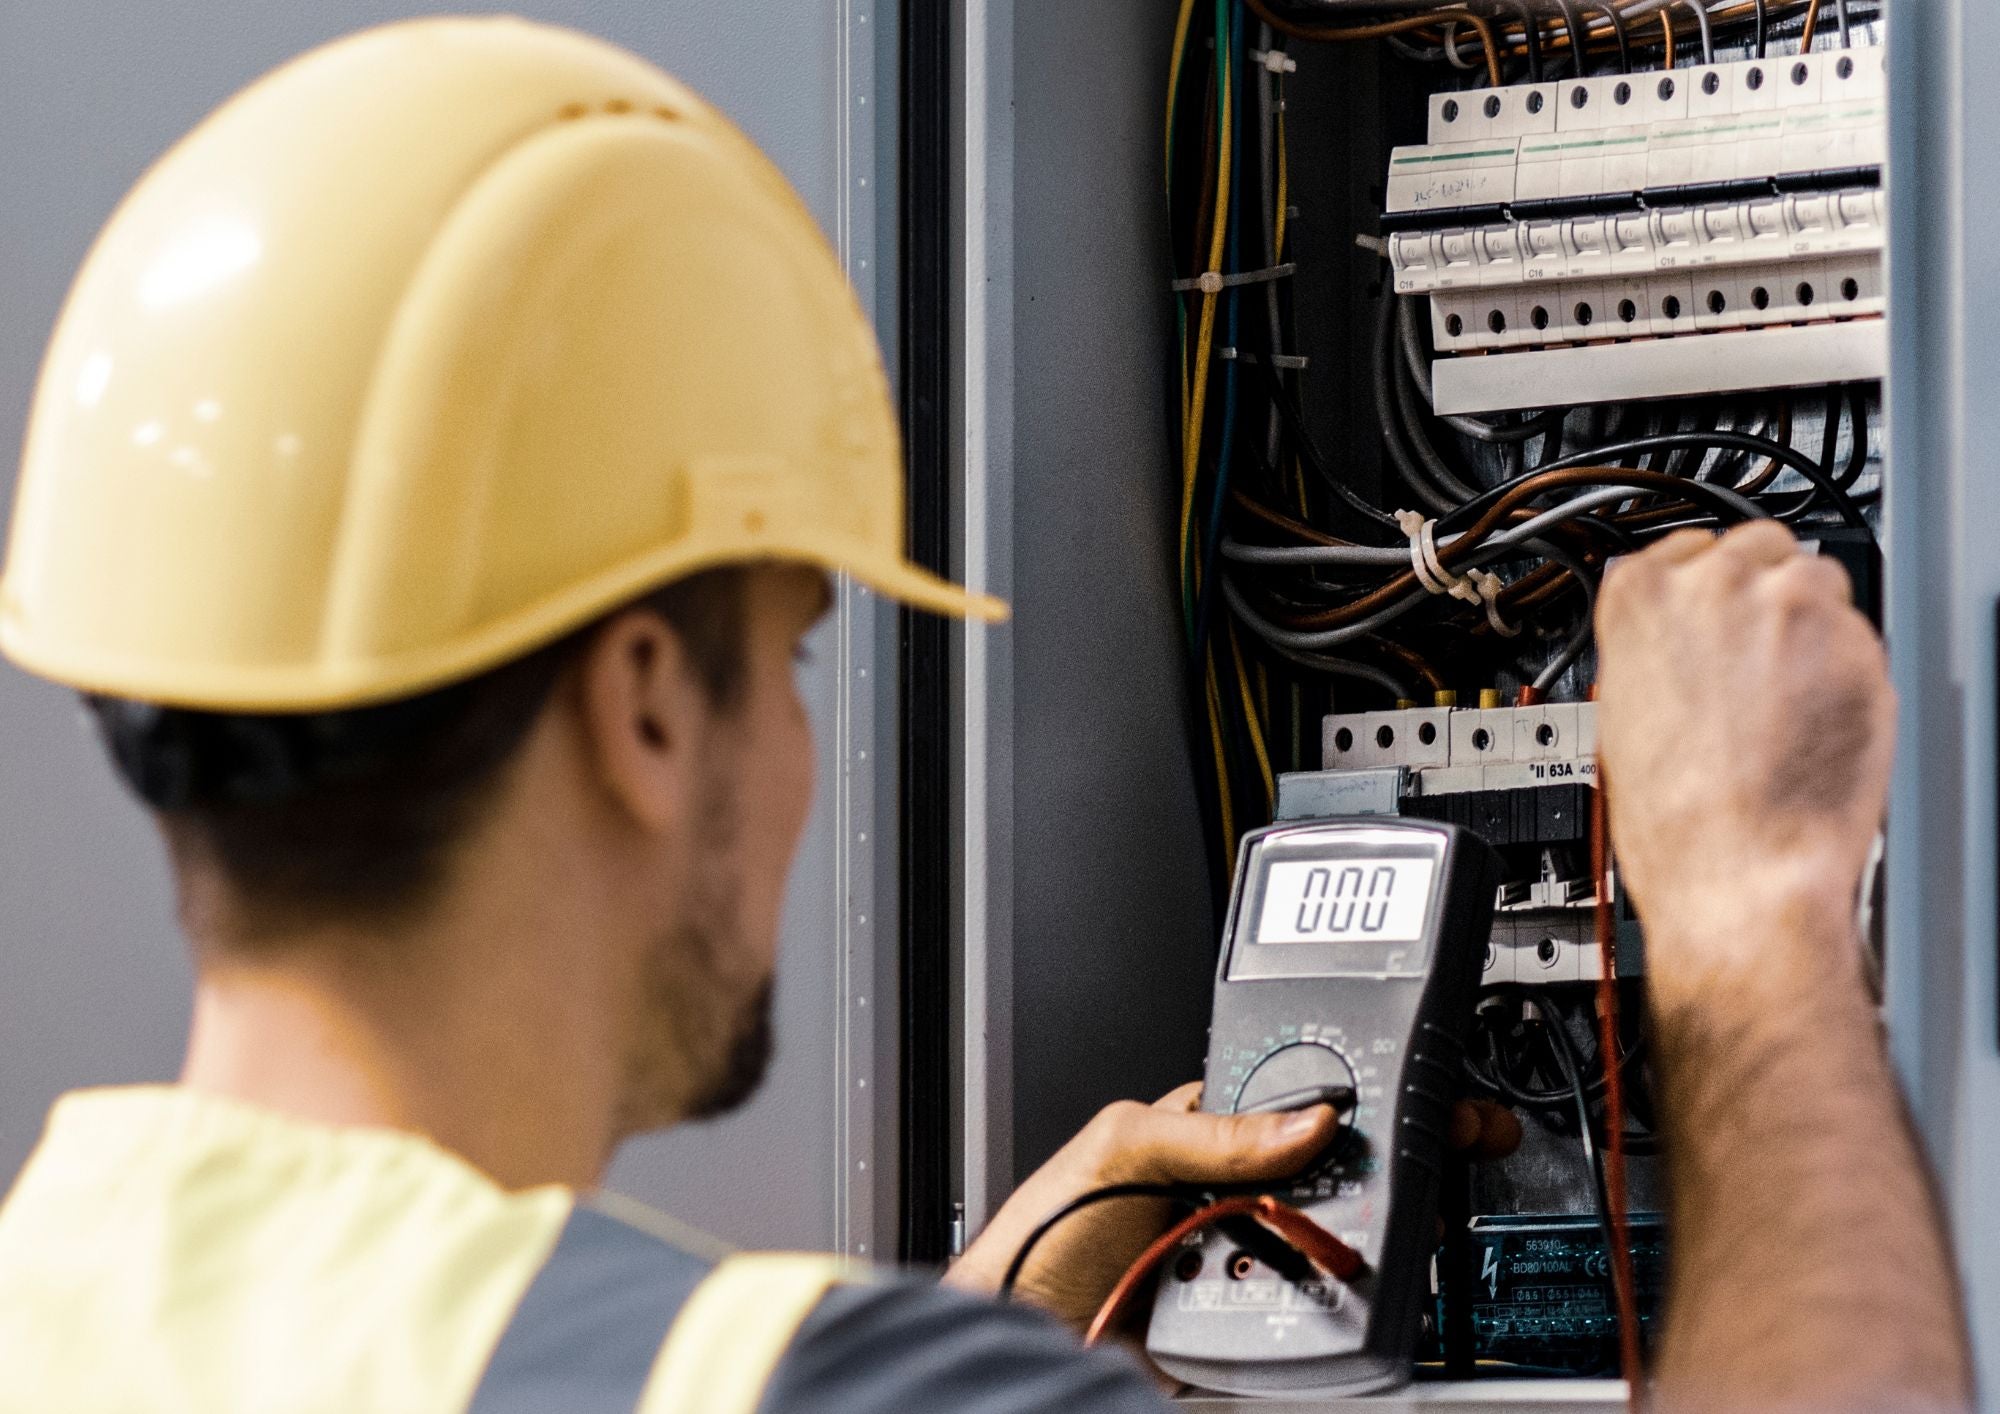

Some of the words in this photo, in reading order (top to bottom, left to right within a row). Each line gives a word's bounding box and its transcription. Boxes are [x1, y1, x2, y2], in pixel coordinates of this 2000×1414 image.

[1660, 256, 1676, 266] C16
[1528, 269, 1543, 278] C16
[1399, 280, 1414, 289] C16
[1549, 763, 1573, 777] 63A
[1295, 867, 1396, 933] 000
